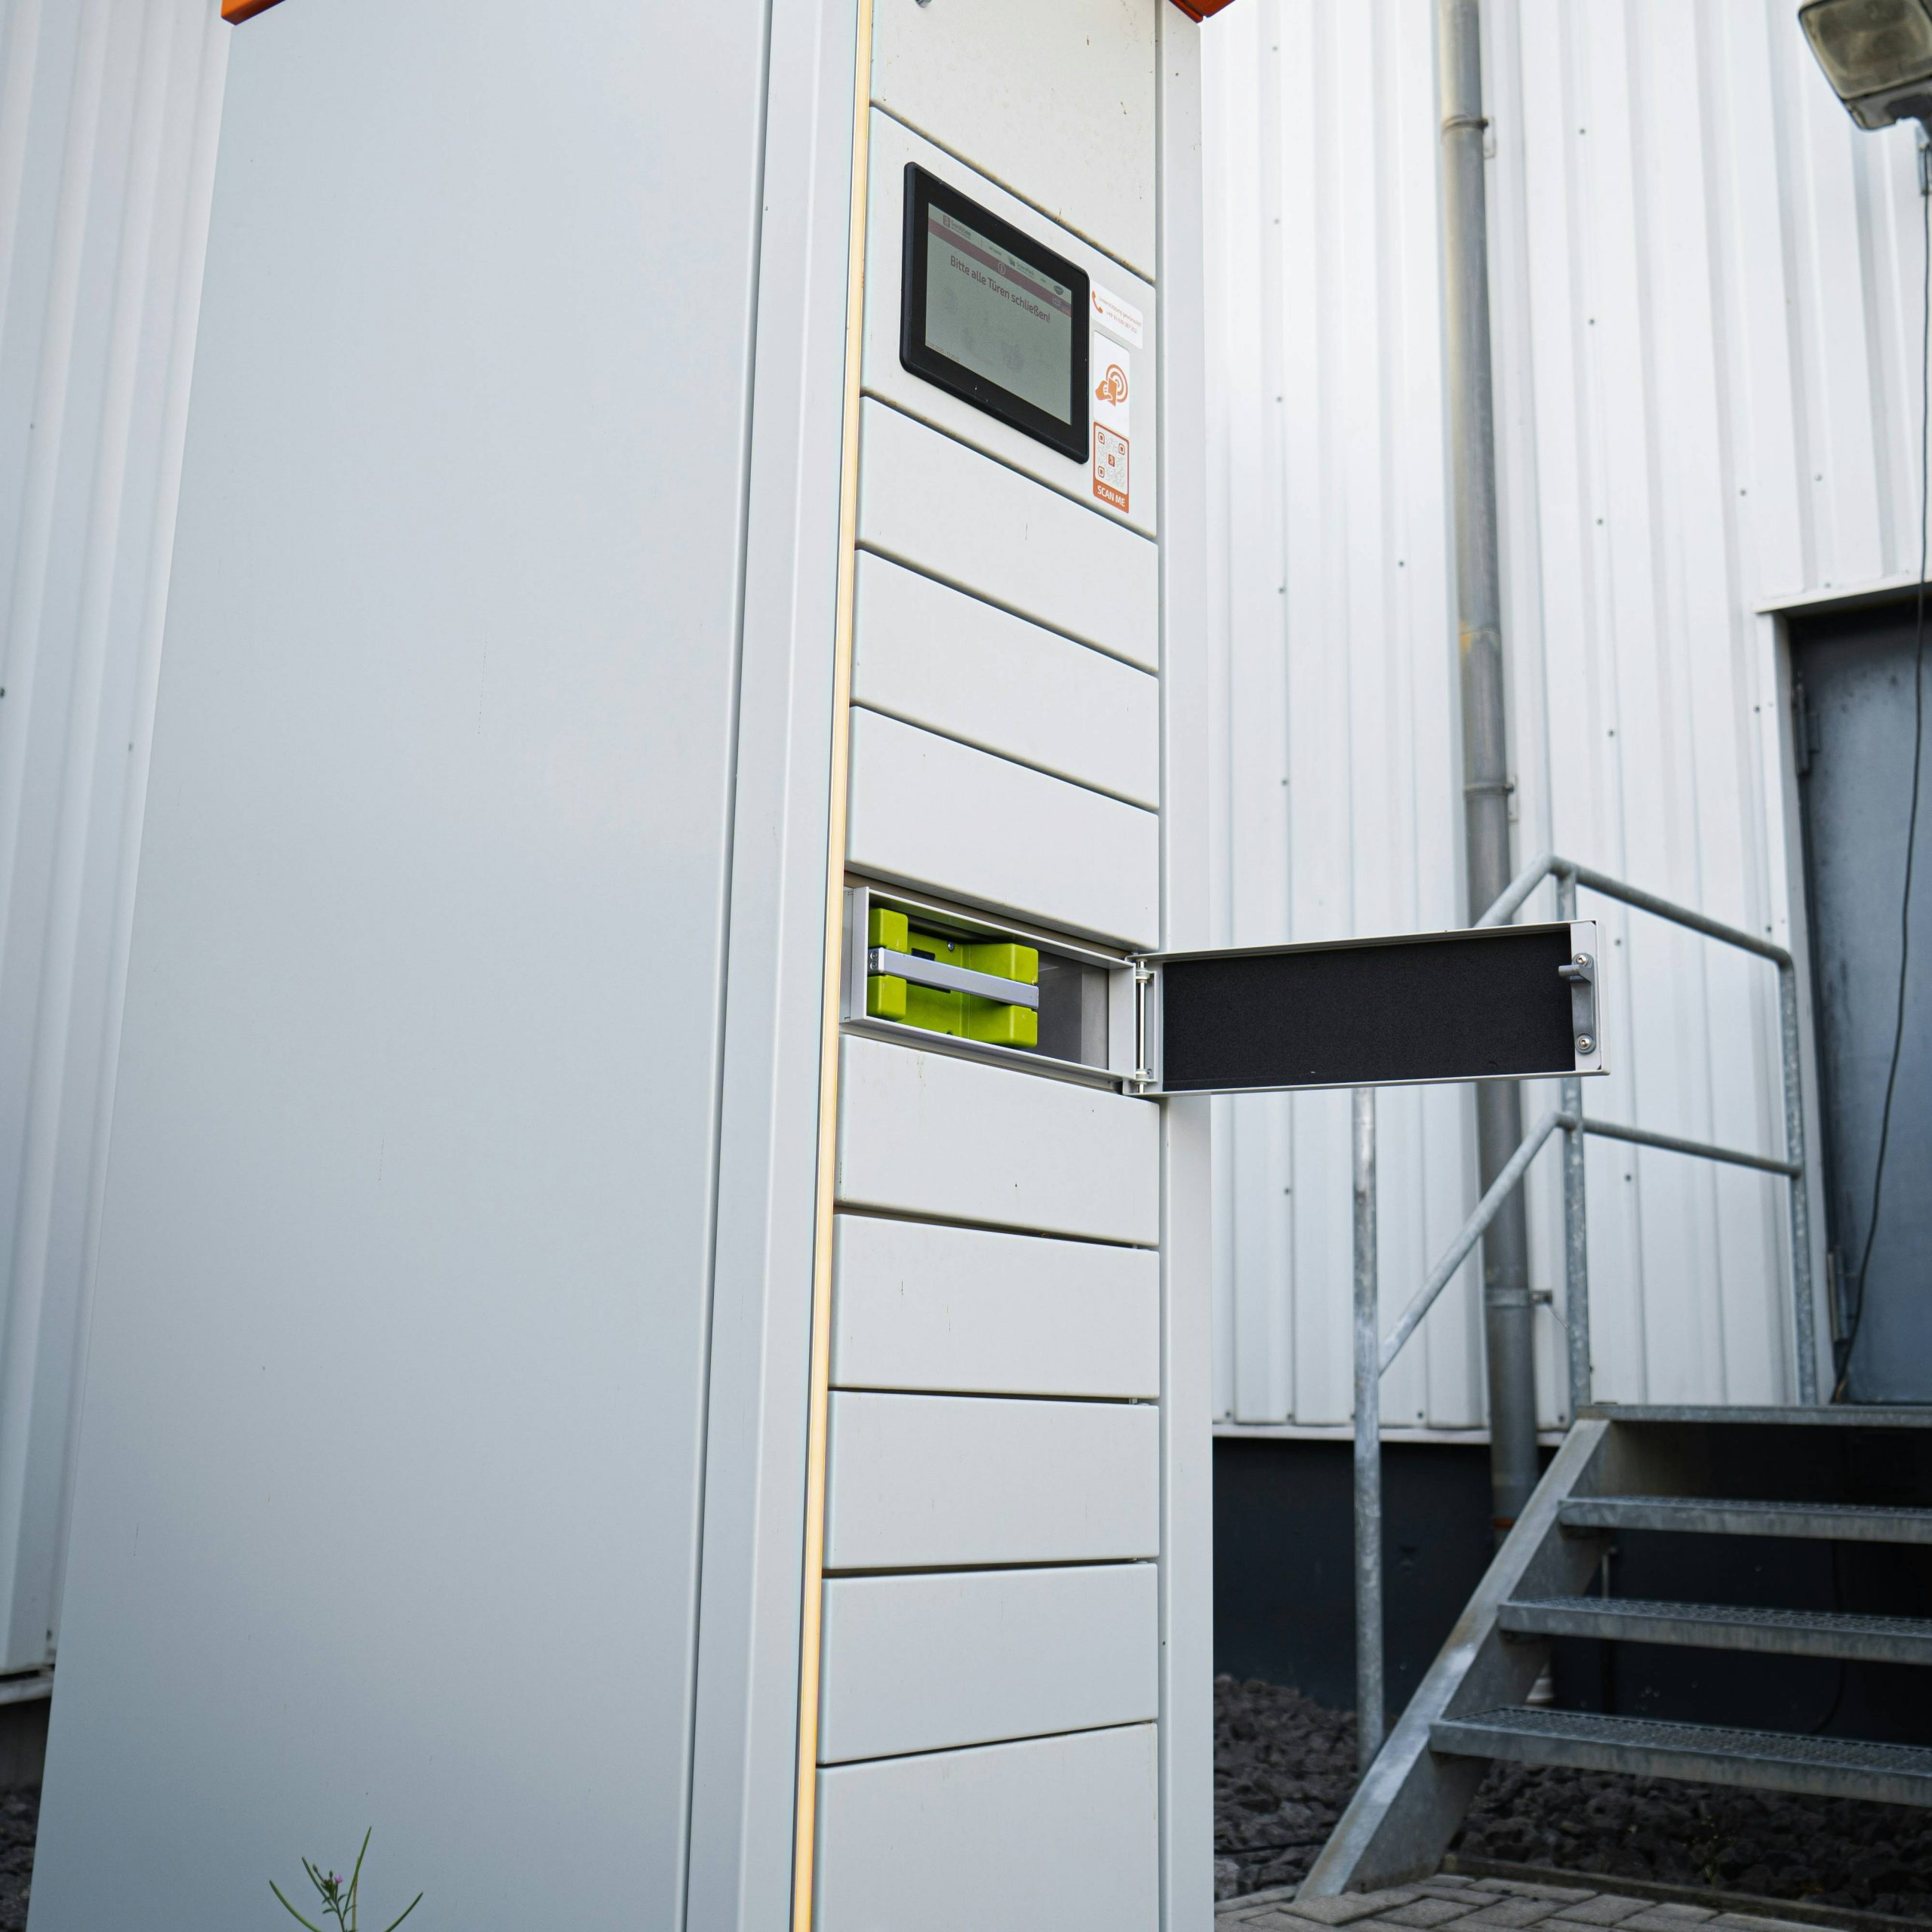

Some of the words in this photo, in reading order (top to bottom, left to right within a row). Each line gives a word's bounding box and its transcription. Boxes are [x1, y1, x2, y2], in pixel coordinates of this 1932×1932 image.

[950, 255, 970, 276] Bitte
[971, 270, 986, 285] alle
[988, 277, 1010, 300] Türen
[1011, 294, 1051, 324] schließen!
[1097, 485, 1115, 502] SCAN
[1115, 494, 1126, 507] ME
